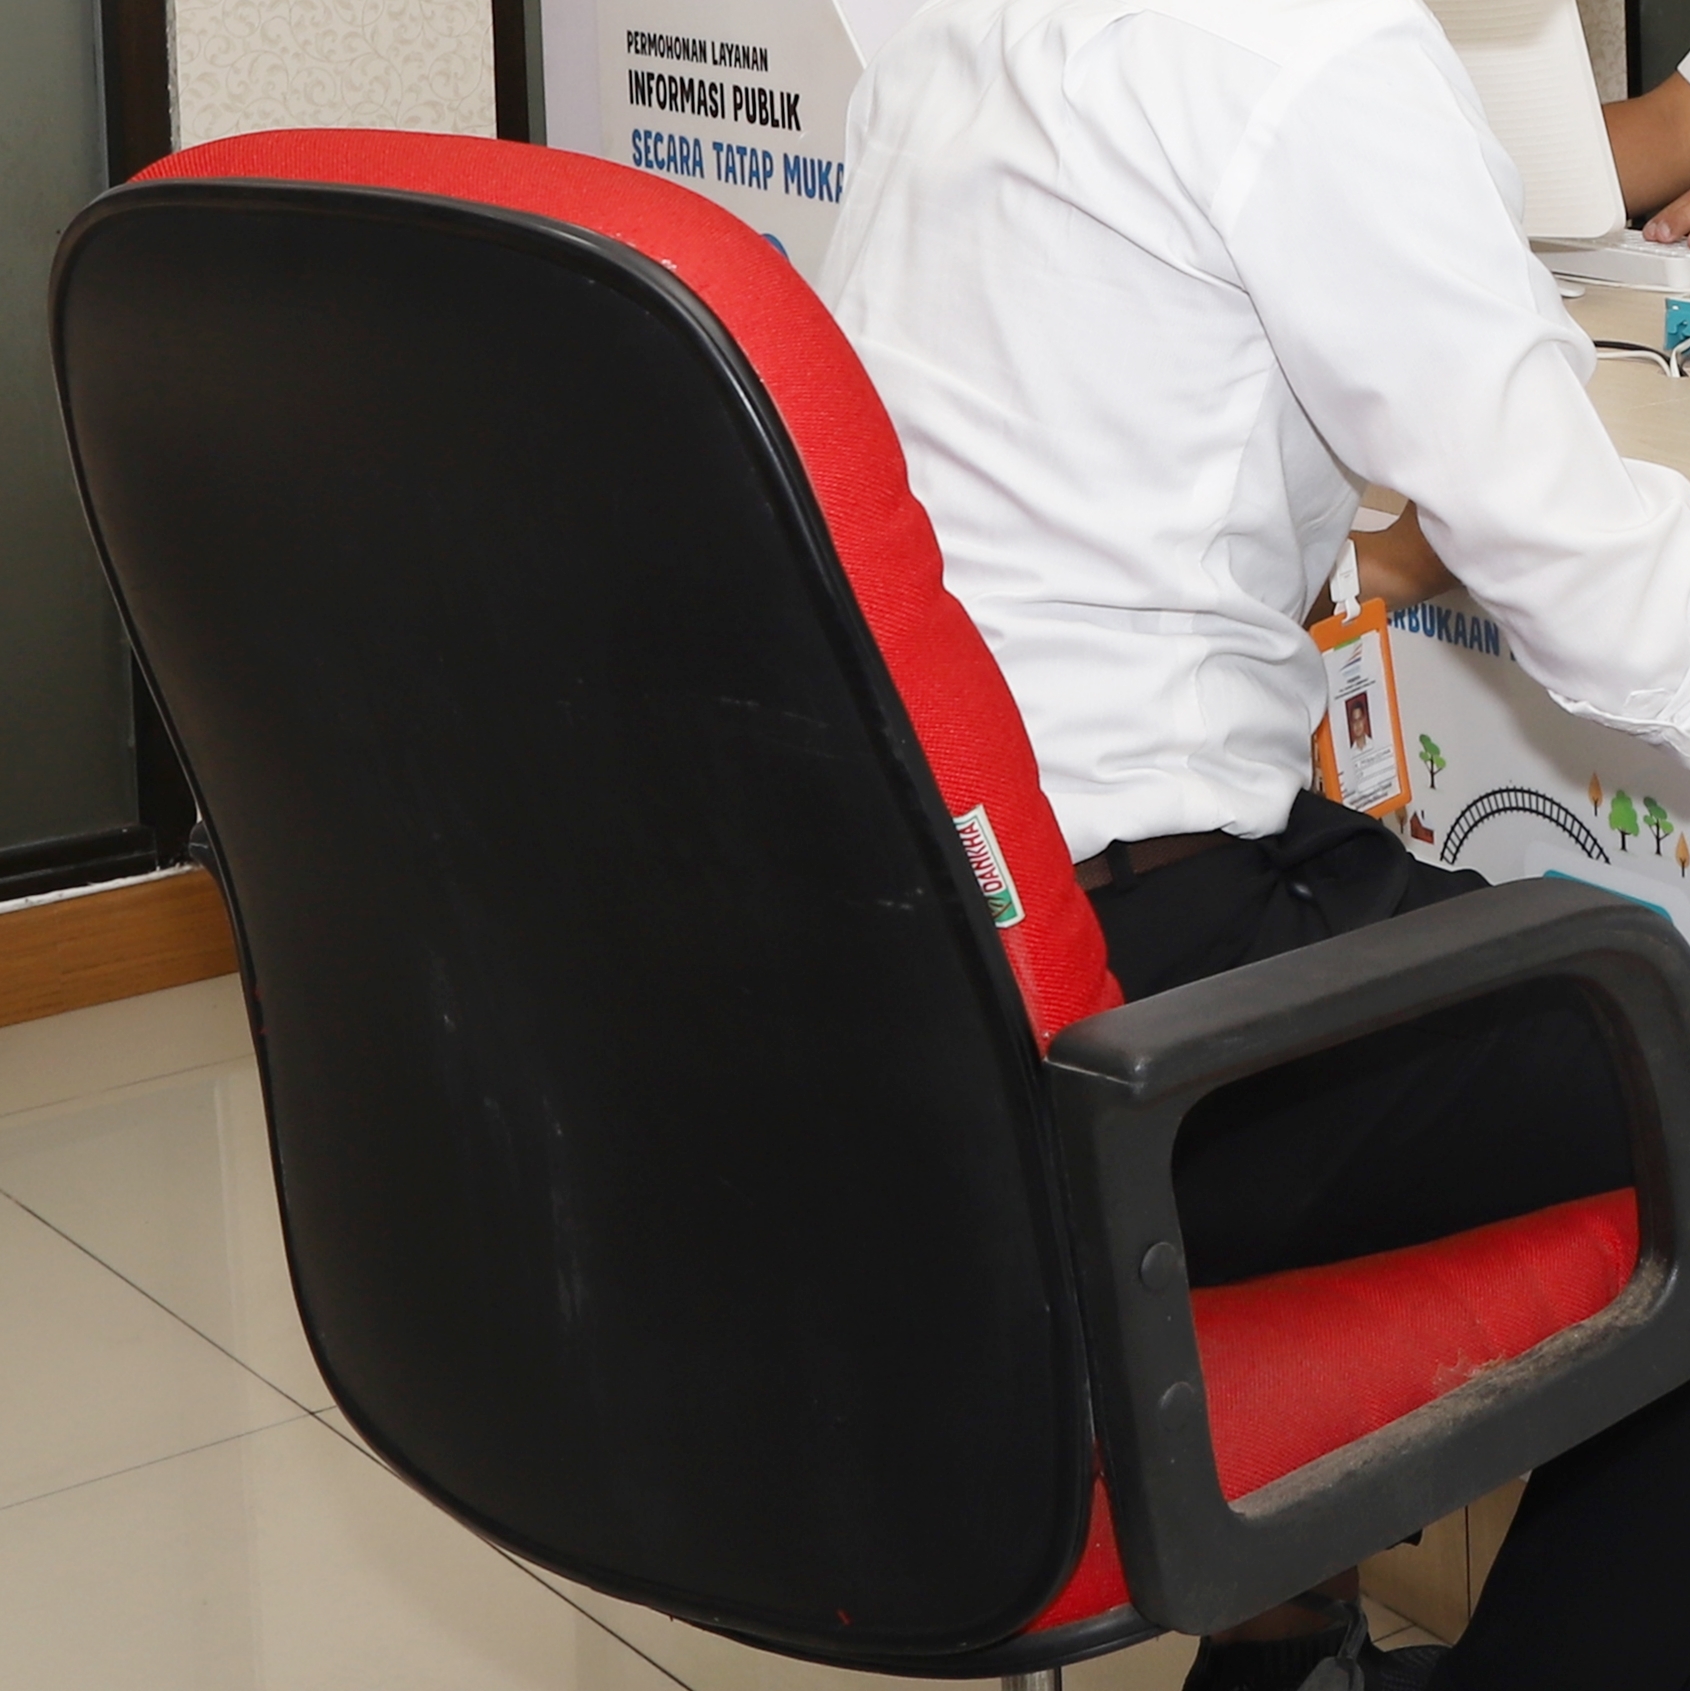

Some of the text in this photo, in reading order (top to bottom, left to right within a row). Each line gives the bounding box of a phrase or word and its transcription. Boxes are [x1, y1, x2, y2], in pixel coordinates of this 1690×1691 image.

[626, 30, 768, 72] PERMOHONAN LAYANAN
[628, 69, 801, 131] INFORMASI PUBLIK
[632, 128, 704, 179] SECARA
[712, 141, 774, 190] TATAP
